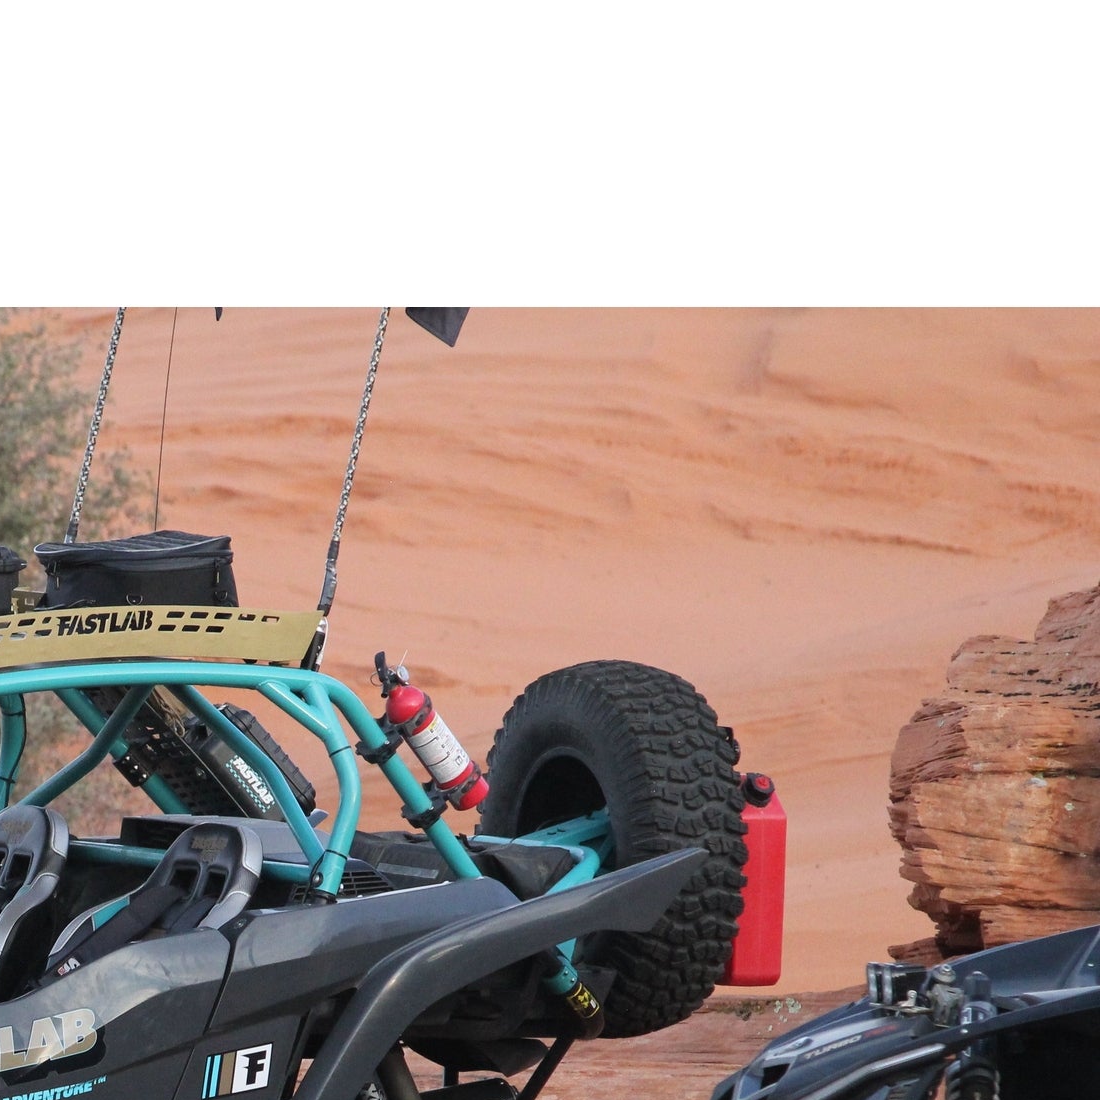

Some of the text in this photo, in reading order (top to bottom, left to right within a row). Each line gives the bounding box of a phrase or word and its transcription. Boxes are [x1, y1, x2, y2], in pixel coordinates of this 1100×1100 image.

[56, 610, 154, 636] FASTLAB
[233, 756, 274, 805] FASTLAB
[241, 1050, 267, 1086] F
